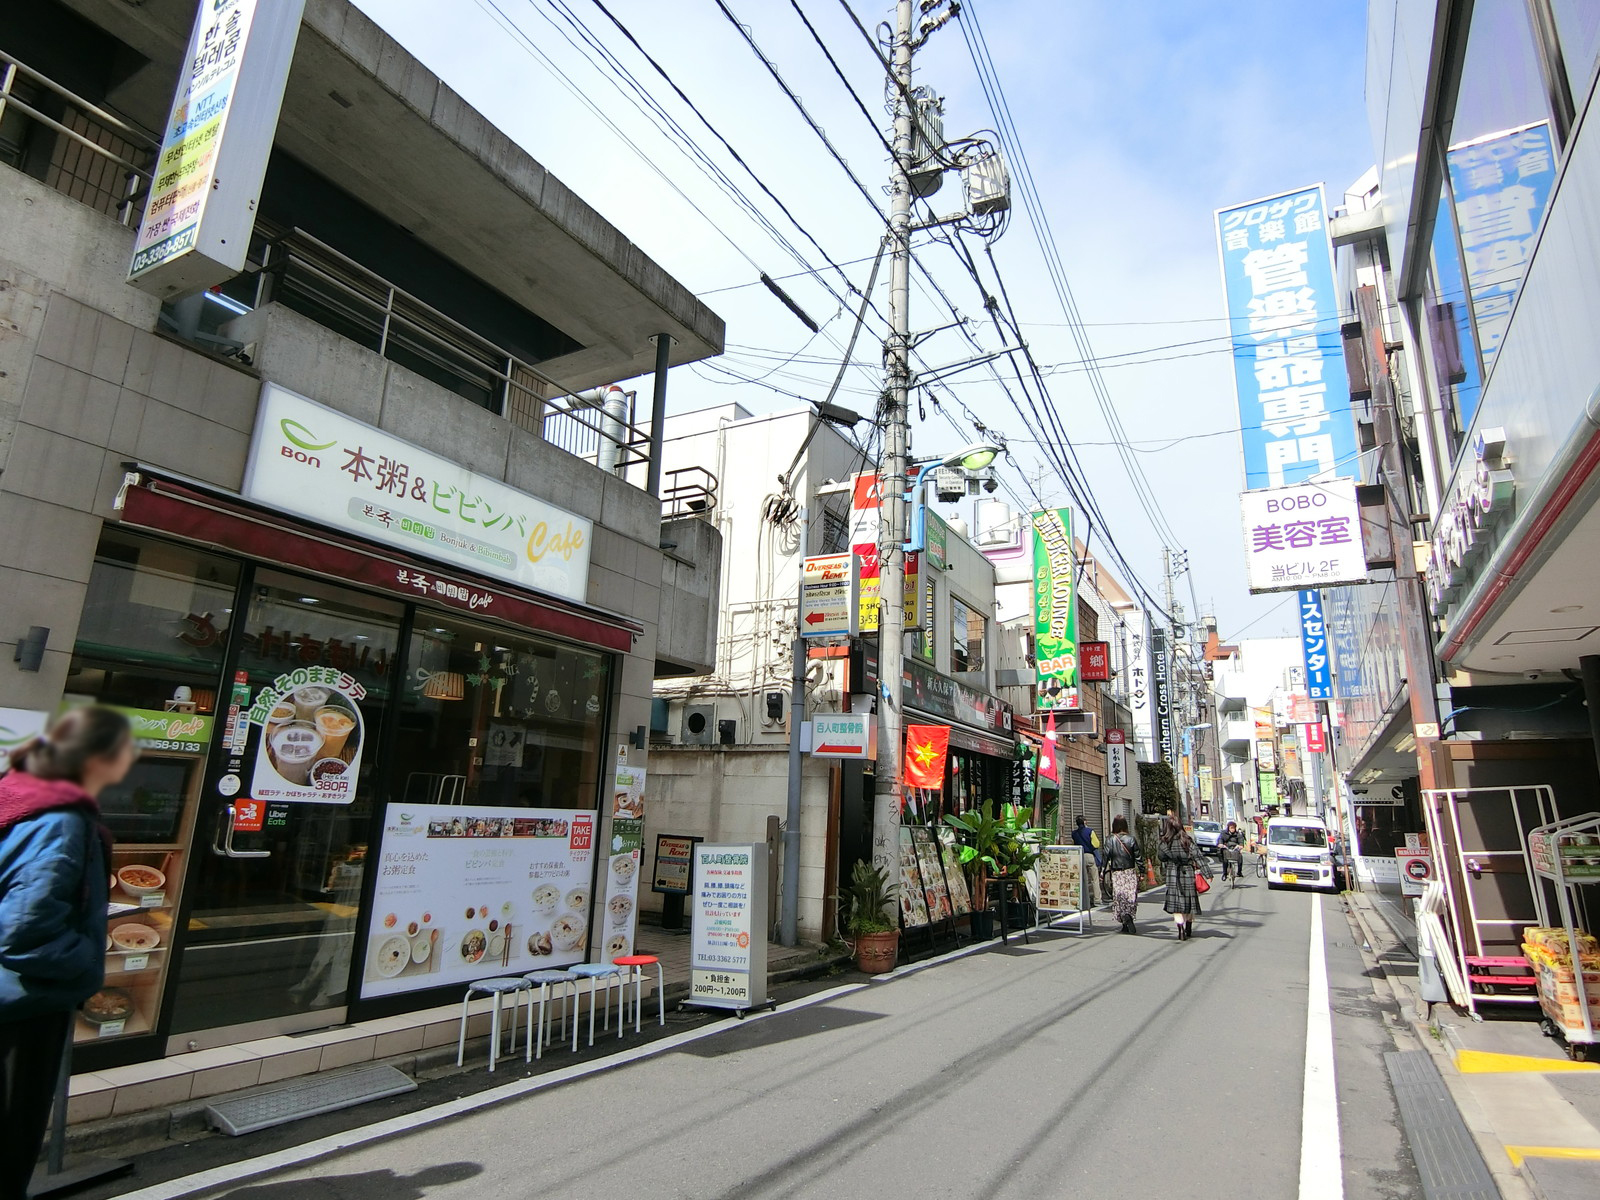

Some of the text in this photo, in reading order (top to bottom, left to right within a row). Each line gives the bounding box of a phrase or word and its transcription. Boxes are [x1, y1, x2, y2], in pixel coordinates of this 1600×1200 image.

[195, 92, 216, 113] NTT
[1224, 193, 1317, 231] クロサワ
[1266, 493, 1328, 513] BOBO
[440, 532, 468, 550] Bonjuk
[526, 521, 585, 563] Cafe
[1252, 516, 1353, 553] 美容室
[806, 563, 842, 572] OVERSEAS
[821, 570, 848, 580] REMIT
[1271, 559, 1340, 578] 当ビル 2F
[469, 592, 494, 609] Cafe
[1302, 588, 1327, 684] ースセンター
[1039, 656, 1074, 673] BAR
[1156, 651, 1167, 680] Hotel
[1058, 697, 1074, 708] 2F
[1158, 684, 1168, 715] Cross
[167, 715, 205, 739] Cafe
[816, 722, 864, 734] 百人町整骨院
[1112, 747, 1121, 783] おかめ食堂
[1023, 760, 1031, 792] 新大久保
[315, 781, 349, 792] 380円
[269, 810, 288, 818] Uber
[572, 826, 591, 835] TAKE
[573, 837, 589, 846] OUT
[385, 852, 429, 863] 真心を込めた
[701, 854, 749, 865] 百人町整骨院
[383, 865, 417, 876] お粥定食
